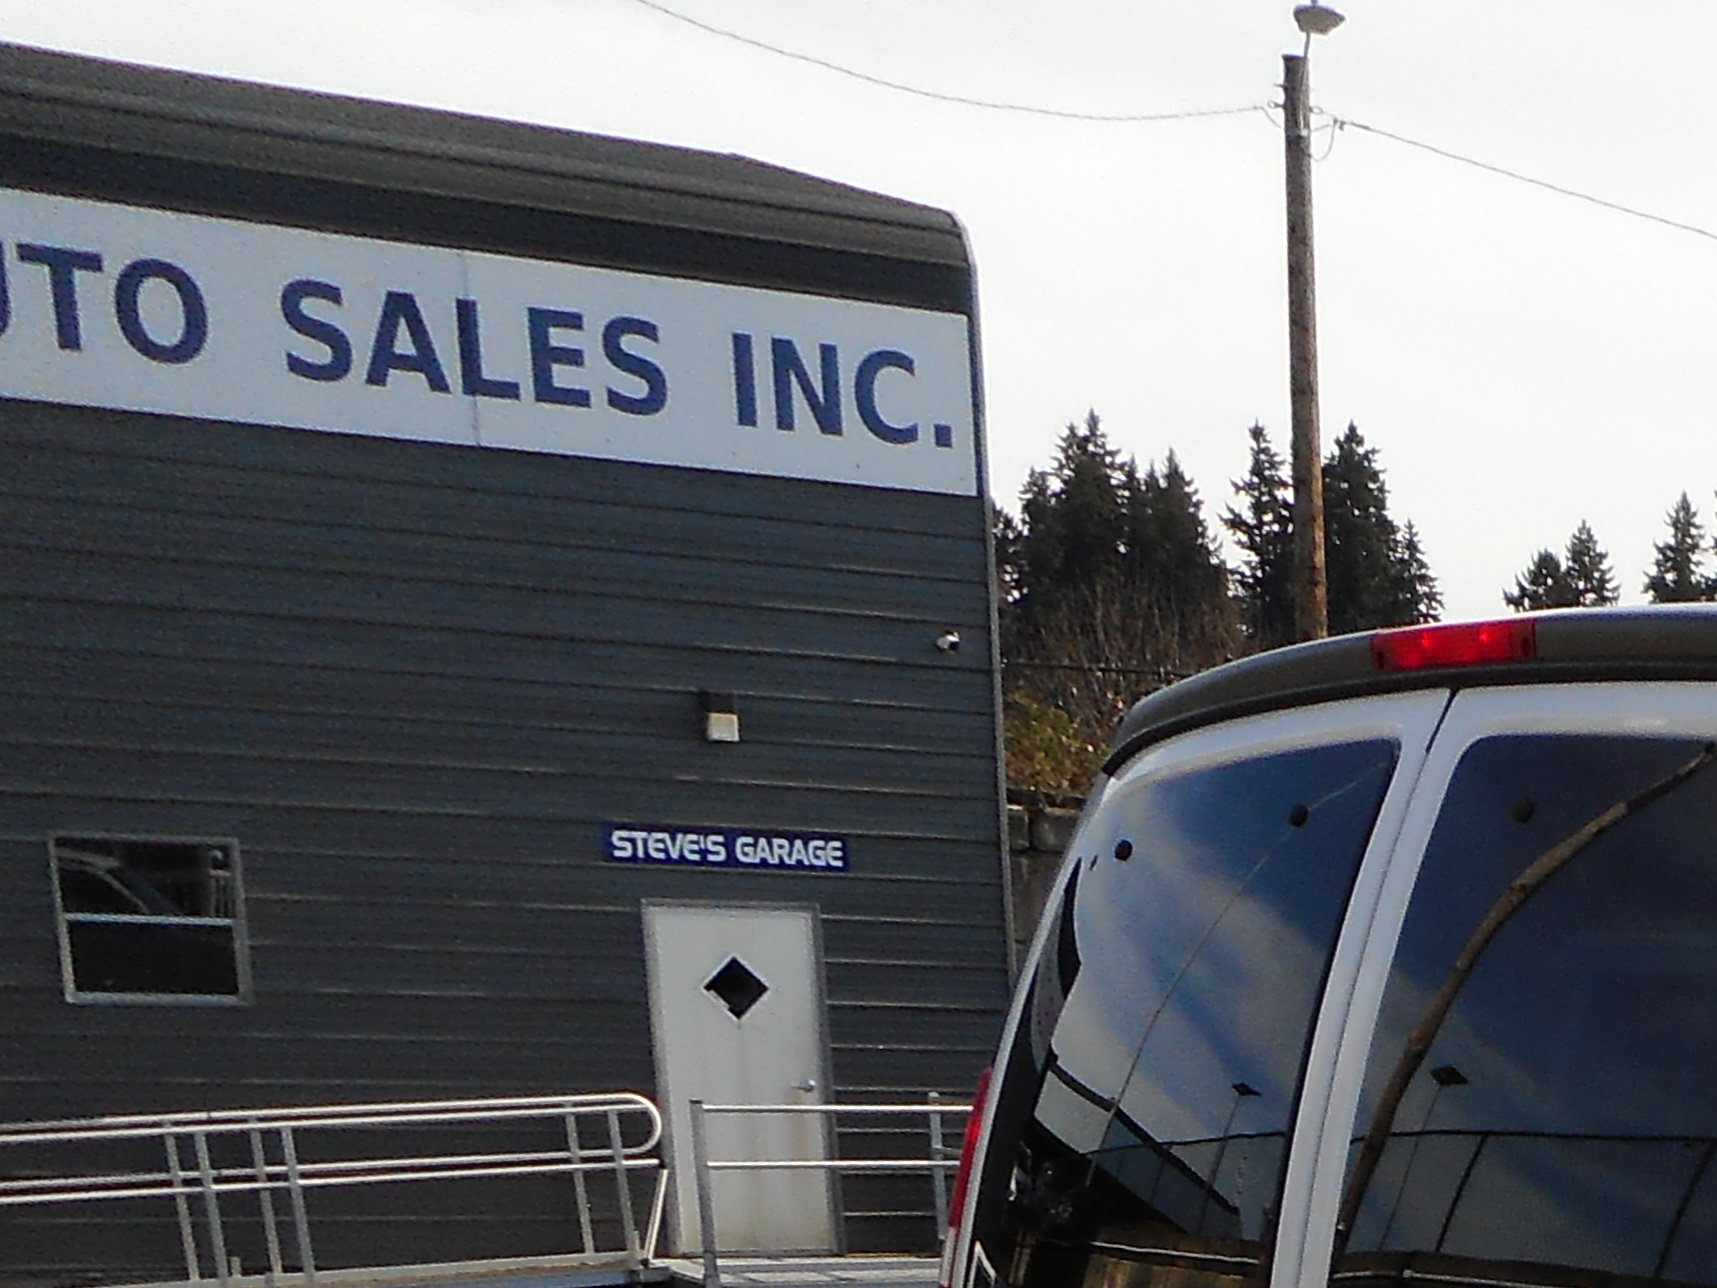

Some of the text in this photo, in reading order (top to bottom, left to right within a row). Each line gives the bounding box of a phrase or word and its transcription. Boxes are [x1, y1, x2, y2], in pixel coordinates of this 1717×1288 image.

[0, 241, 954, 449] TO SALES INC.
[611, 830, 844, 867] STEVE'S GARAGE
